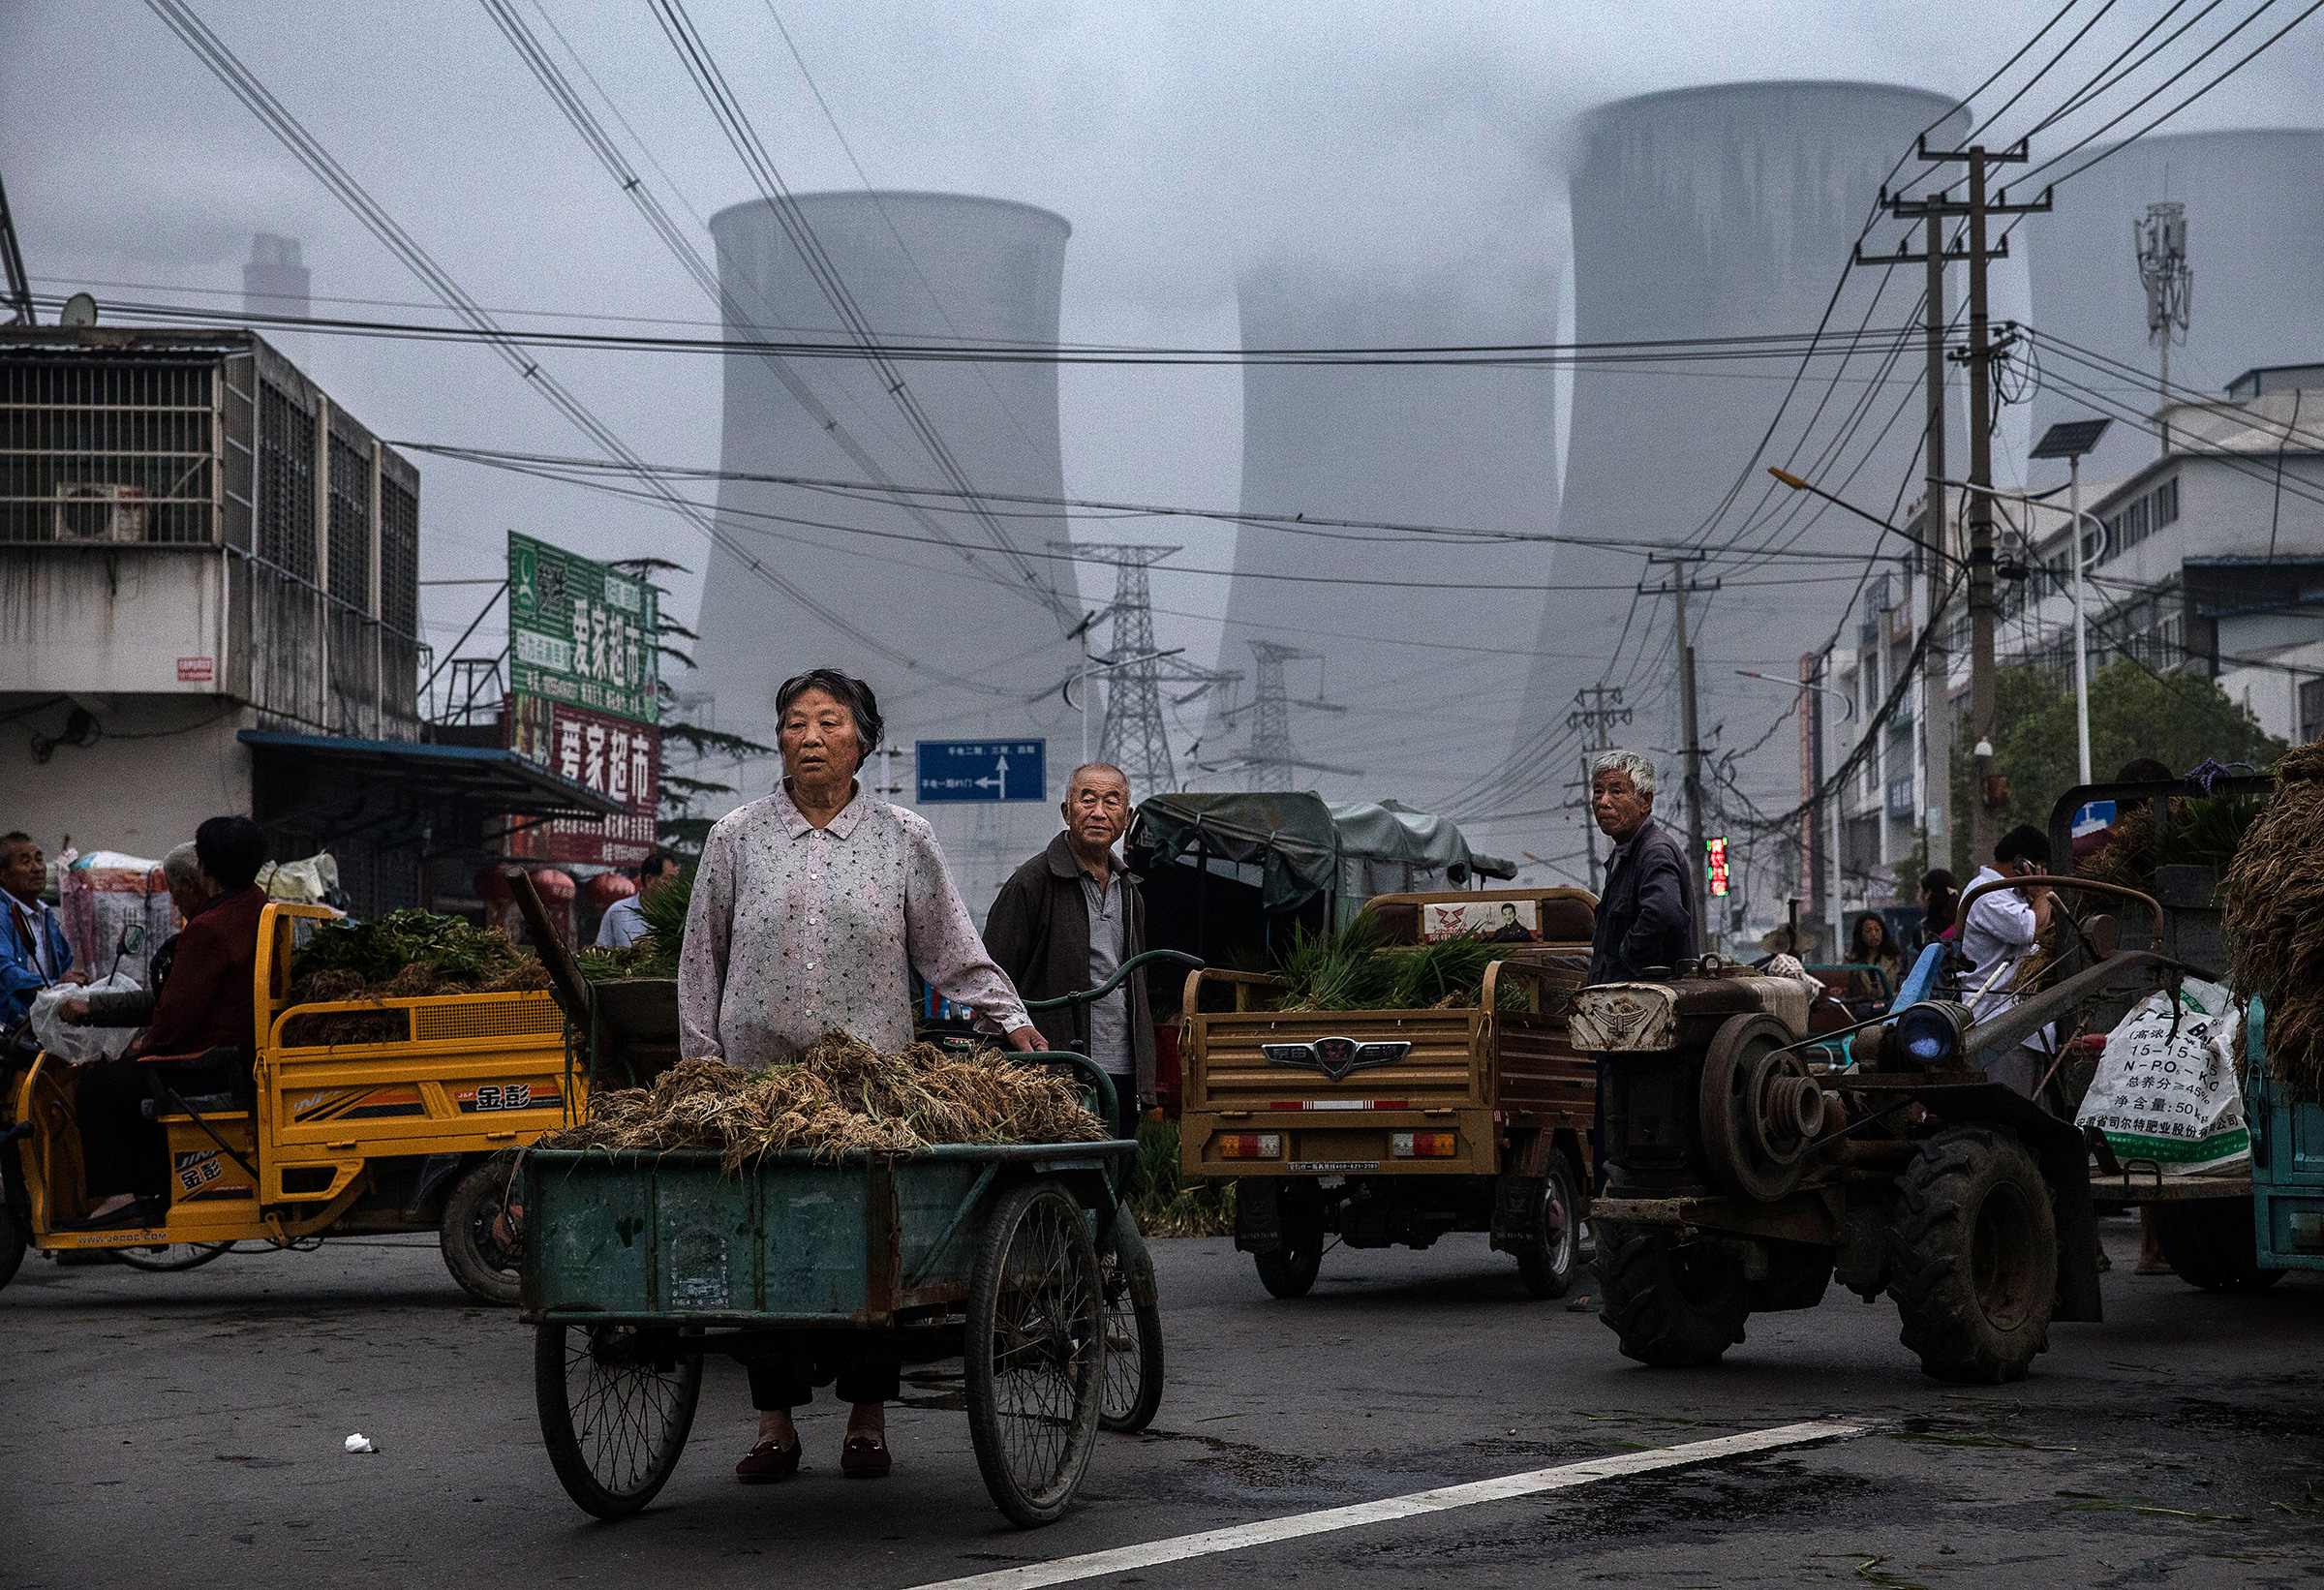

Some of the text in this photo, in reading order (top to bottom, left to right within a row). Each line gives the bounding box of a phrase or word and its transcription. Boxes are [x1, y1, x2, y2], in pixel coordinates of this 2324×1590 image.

[573, 599, 641, 689] 爱家超市
[560, 719, 650, 805] 爱家超市
[476, 1084, 531, 1111] 金彭
[180, 1157, 223, 1191] 金彭
